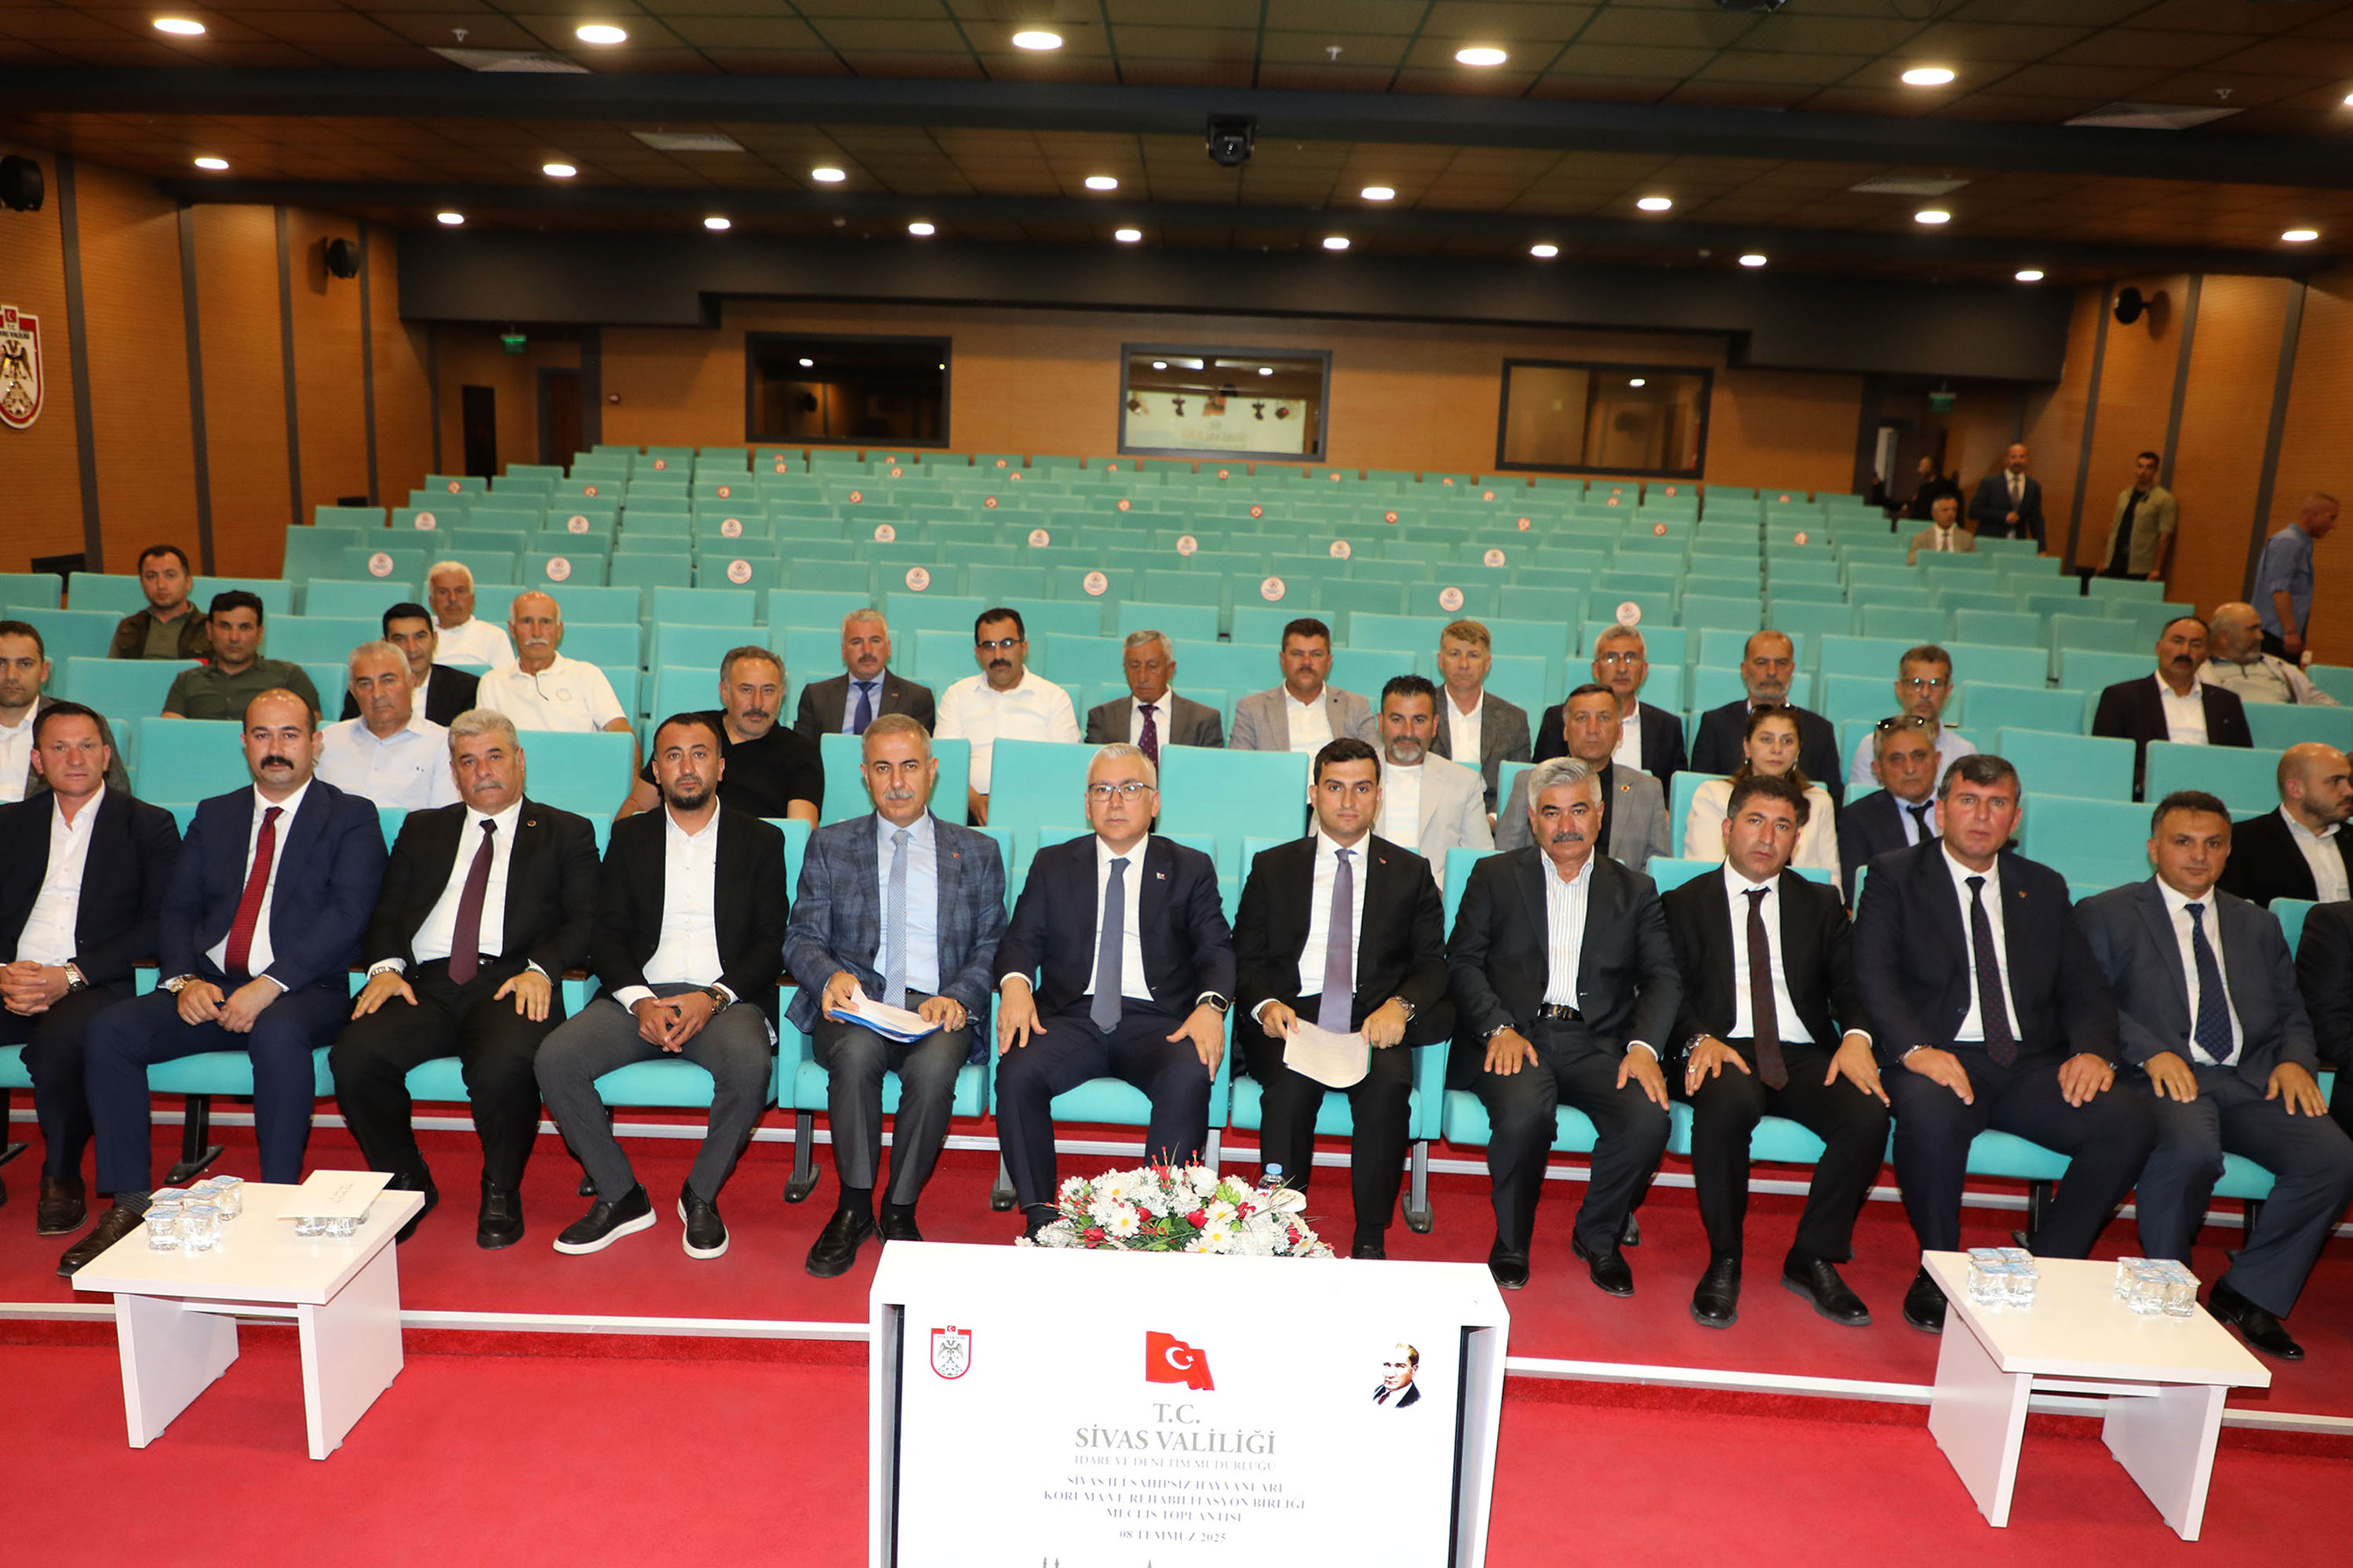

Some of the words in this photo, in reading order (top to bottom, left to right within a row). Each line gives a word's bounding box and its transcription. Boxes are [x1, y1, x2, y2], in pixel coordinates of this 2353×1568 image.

[1152, 1402, 1200, 1424] T.C.
[1075, 1424, 1149, 1450] SİVAS
[1156, 1428, 1275, 1455] VALİLİĞİ
[1119, 1530, 1133, 1539] 08
[1200, 1532, 1226, 1543] 2025
